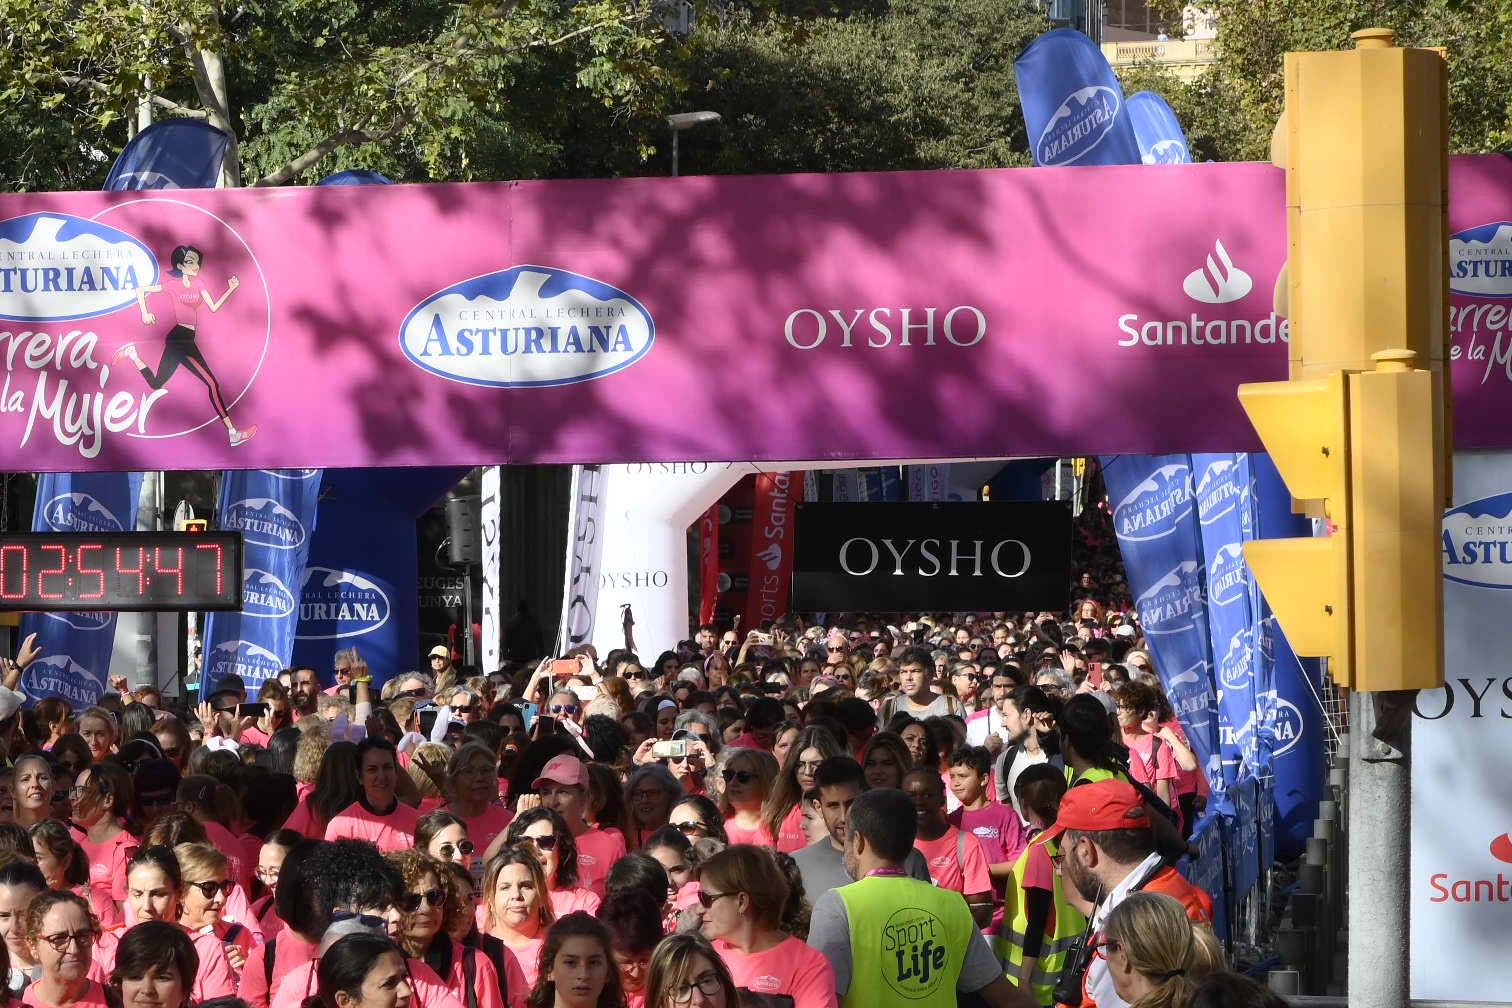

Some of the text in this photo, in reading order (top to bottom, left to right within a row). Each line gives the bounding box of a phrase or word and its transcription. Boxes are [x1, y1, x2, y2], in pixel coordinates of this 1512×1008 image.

[61, 250, 135, 261] LECHERA
[1458, 248, 1511, 256] CENTRAL
[458, 305, 627, 320] CENTRAL LECHERA
[785, 305, 988, 351] OYSHO
[1117, 312, 1289, 347] Santande
[419, 313, 634, 358] ASTURIANA
[0, 373, 25, 412] la
[19, 364, 168, 459] Mujer
[226, 509, 300, 545] ASTURIANA
[0, 544, 222, 599] 02:54:47
[838, 537, 1032, 578] OYSHO
[244, 590, 287, 611] URIANA
[300, 602, 381, 621] URIANA
[885, 916, 937, 951] Sport
[895, 939, 946, 984] Life
